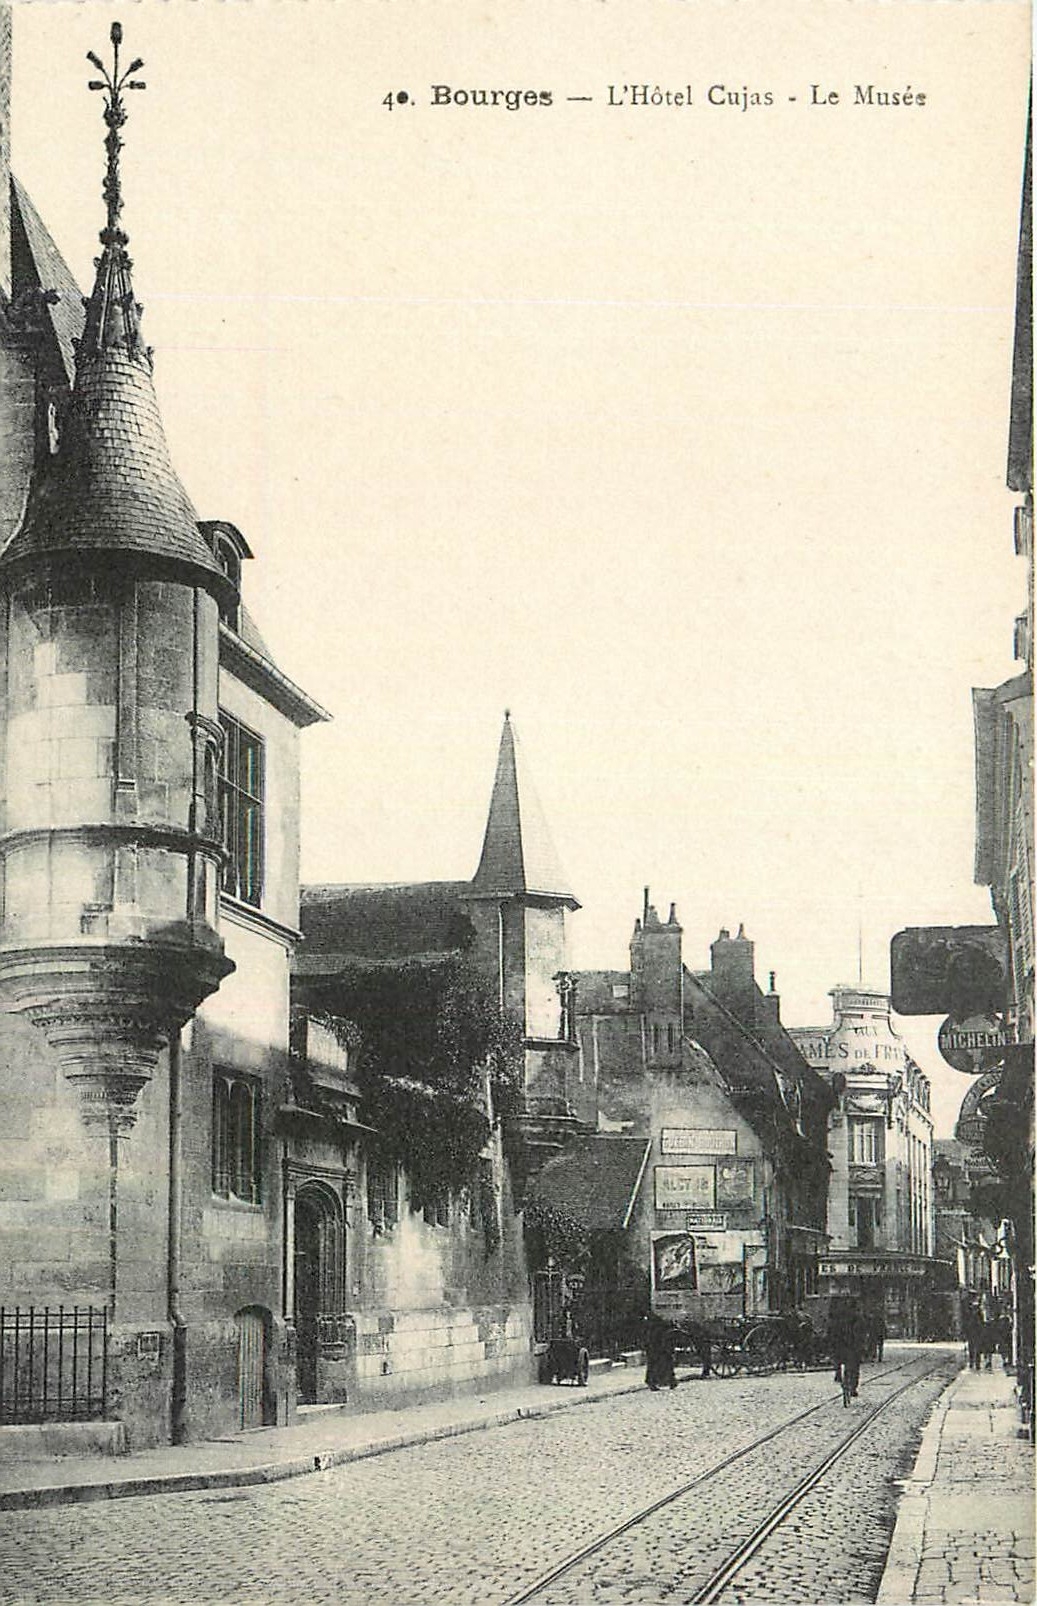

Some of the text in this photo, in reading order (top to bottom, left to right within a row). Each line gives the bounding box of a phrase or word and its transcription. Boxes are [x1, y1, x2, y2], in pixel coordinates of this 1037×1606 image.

[940, 1031, 1006, 1049] MICHELIN
[799, 1042, 849, 1059] AMES
[854, 1049, 871, 1060] DE
